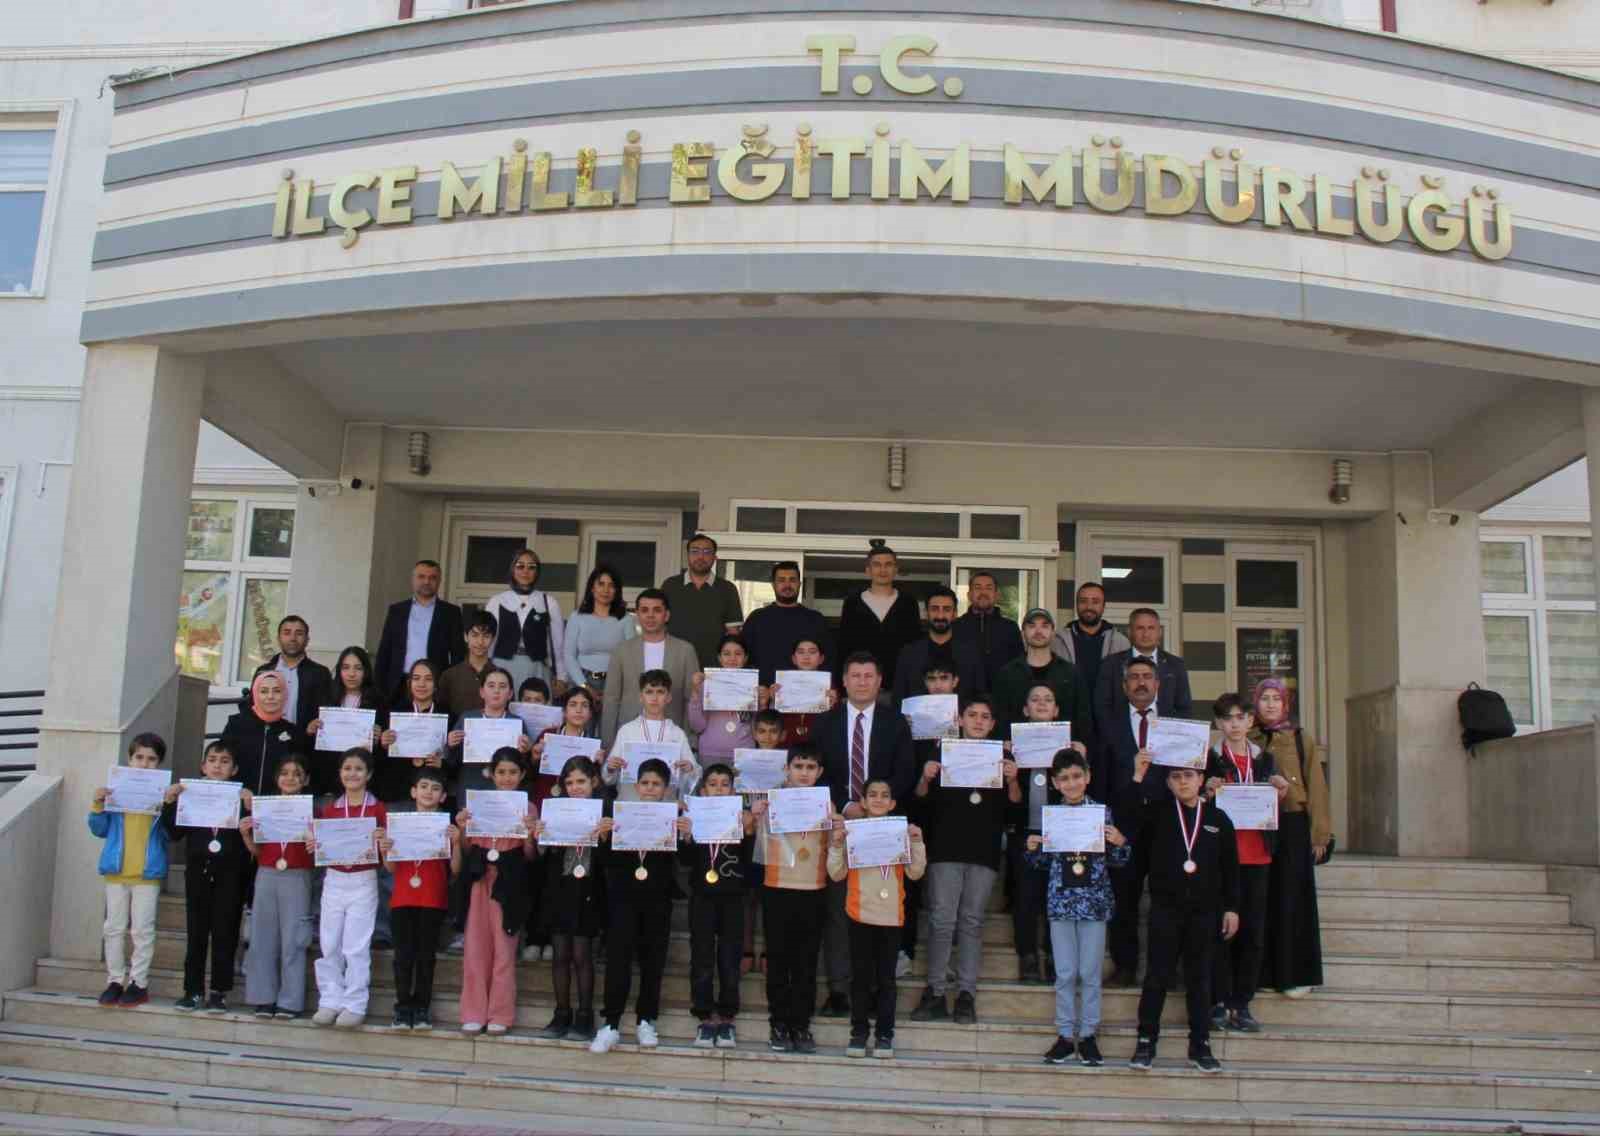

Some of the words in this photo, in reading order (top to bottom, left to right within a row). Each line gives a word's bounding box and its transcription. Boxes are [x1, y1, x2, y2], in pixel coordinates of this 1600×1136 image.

[806, 34, 963, 97] T.C.
[271, 166, 418, 248] İLÇE
[436, 128, 642, 219] MİLLİ
[669, 121, 970, 203] EĞİTİM
[1003, 135, 1512, 261] MÜDÜRLÜĞÜ
